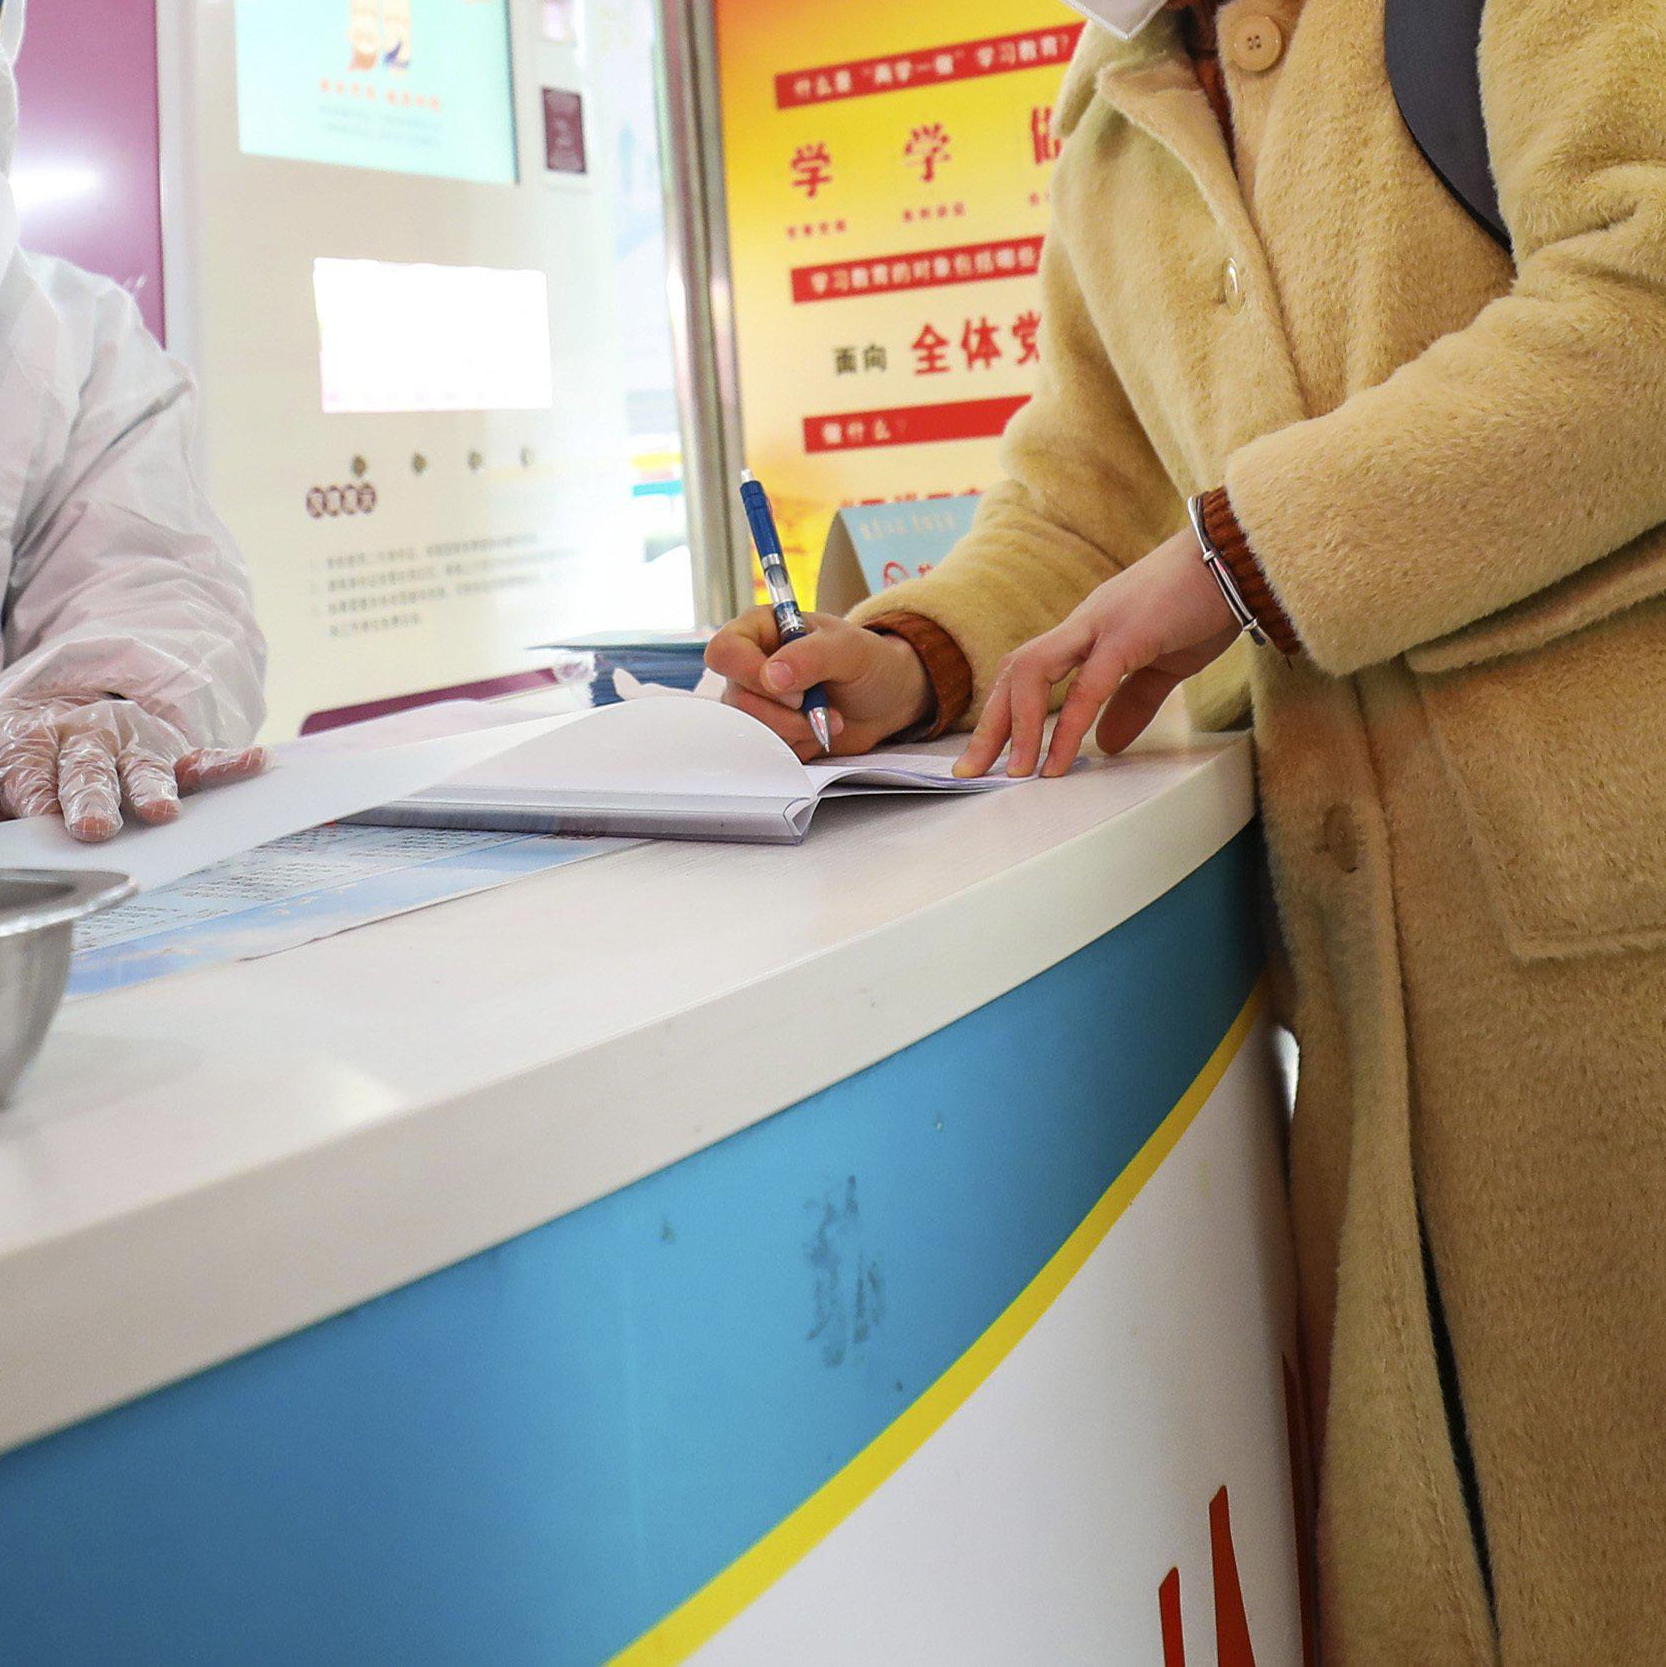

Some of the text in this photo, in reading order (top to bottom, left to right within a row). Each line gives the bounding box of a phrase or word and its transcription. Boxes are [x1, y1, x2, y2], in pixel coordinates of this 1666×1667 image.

[791, 122, 952, 198] 学 学
[834, 310, 1042, 376] 面向 全体党
